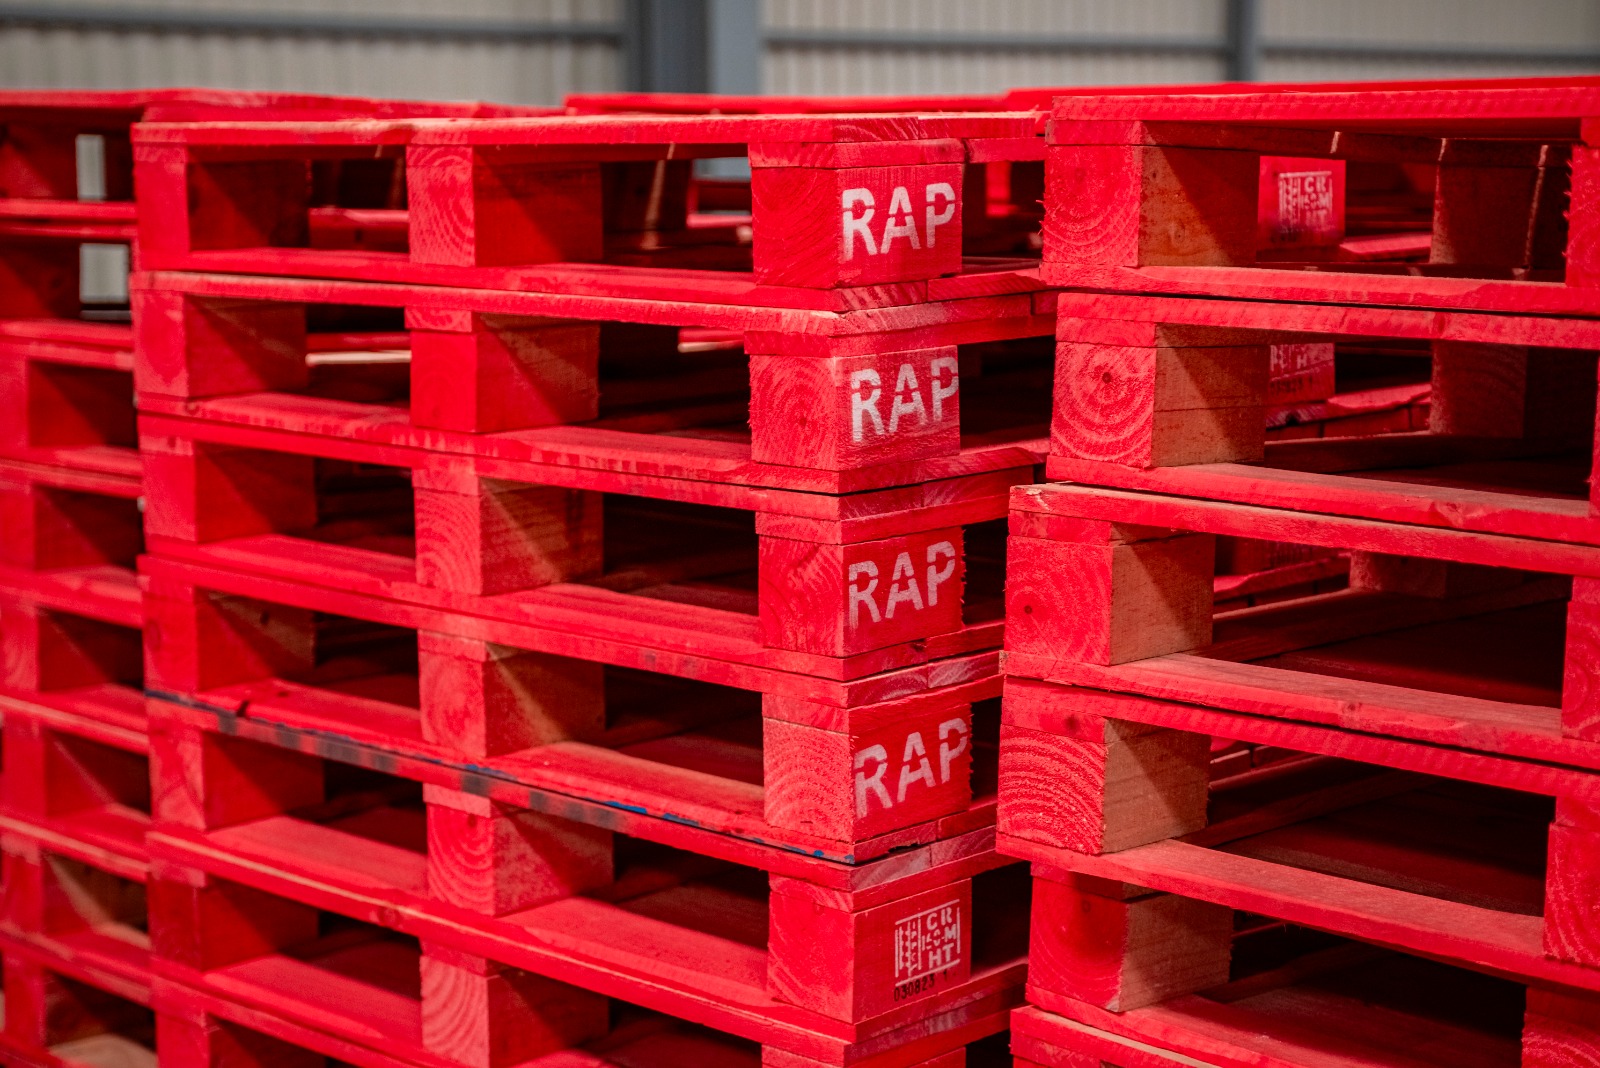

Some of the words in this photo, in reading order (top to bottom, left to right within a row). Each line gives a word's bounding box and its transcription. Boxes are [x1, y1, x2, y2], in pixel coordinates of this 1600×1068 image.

[843, 182, 956, 260] RAP
[850, 357, 959, 445] RAP
[848, 541, 956, 628] RAP
[854, 718, 968, 820] RAP
[926, 907, 953, 931] CR
[928, 942, 955, 969] HT
